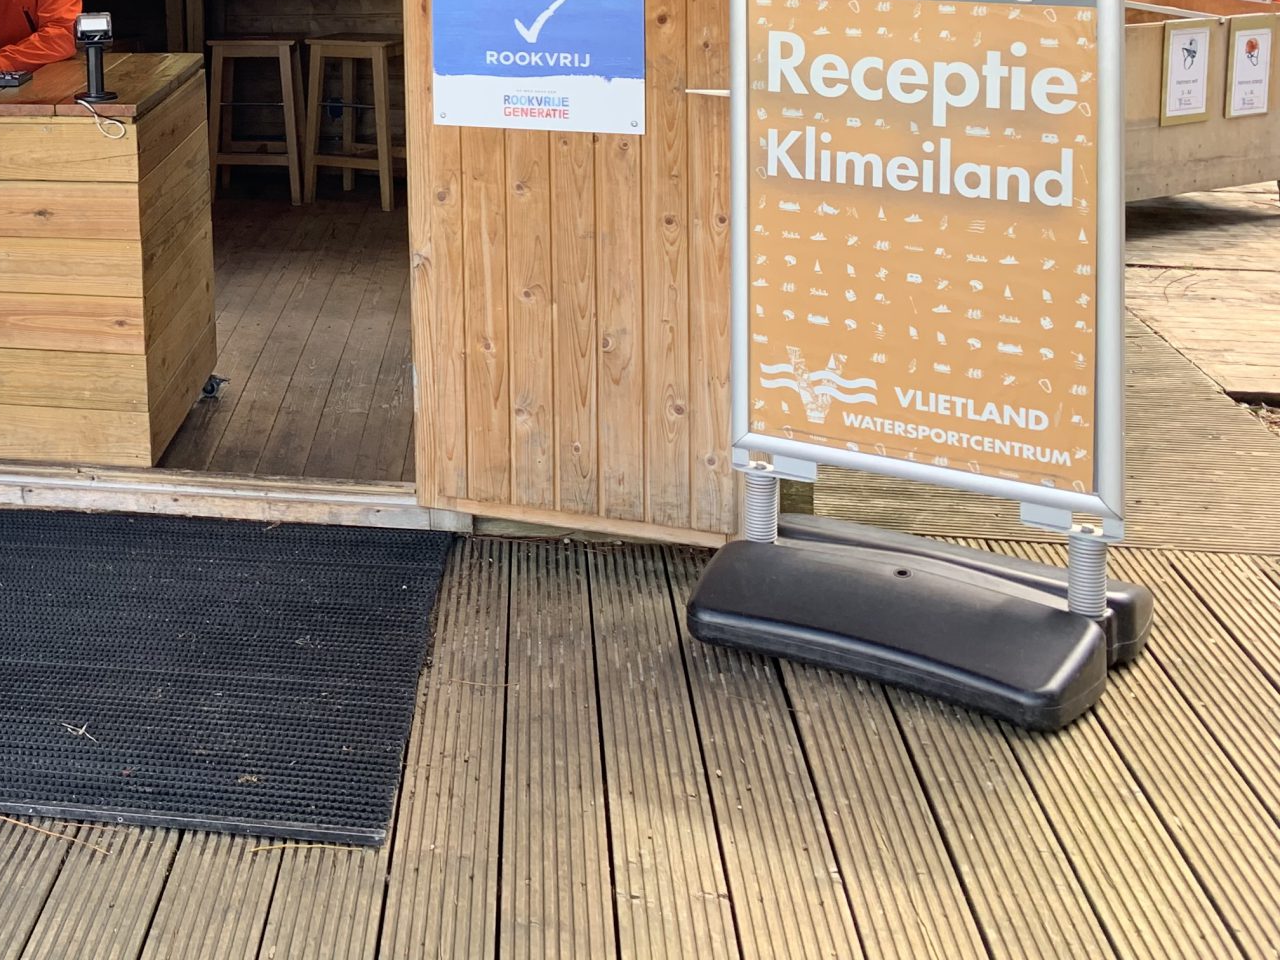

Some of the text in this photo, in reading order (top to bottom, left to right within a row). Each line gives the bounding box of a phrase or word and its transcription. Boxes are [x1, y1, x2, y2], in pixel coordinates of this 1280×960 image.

[485, 50, 591, 68] ROOKVRIJ
[767, 30, 1080, 128] Receptie
[503, 94, 570, 108] ROOKVRIJE
[503, 106, 570, 120] GENERATIE
[767, 124, 1075, 208] Klimeiland
[893, 386, 1050, 432] VLIETLAND
[842, 411, 1073, 467] WATERSPORTCENTRUM
